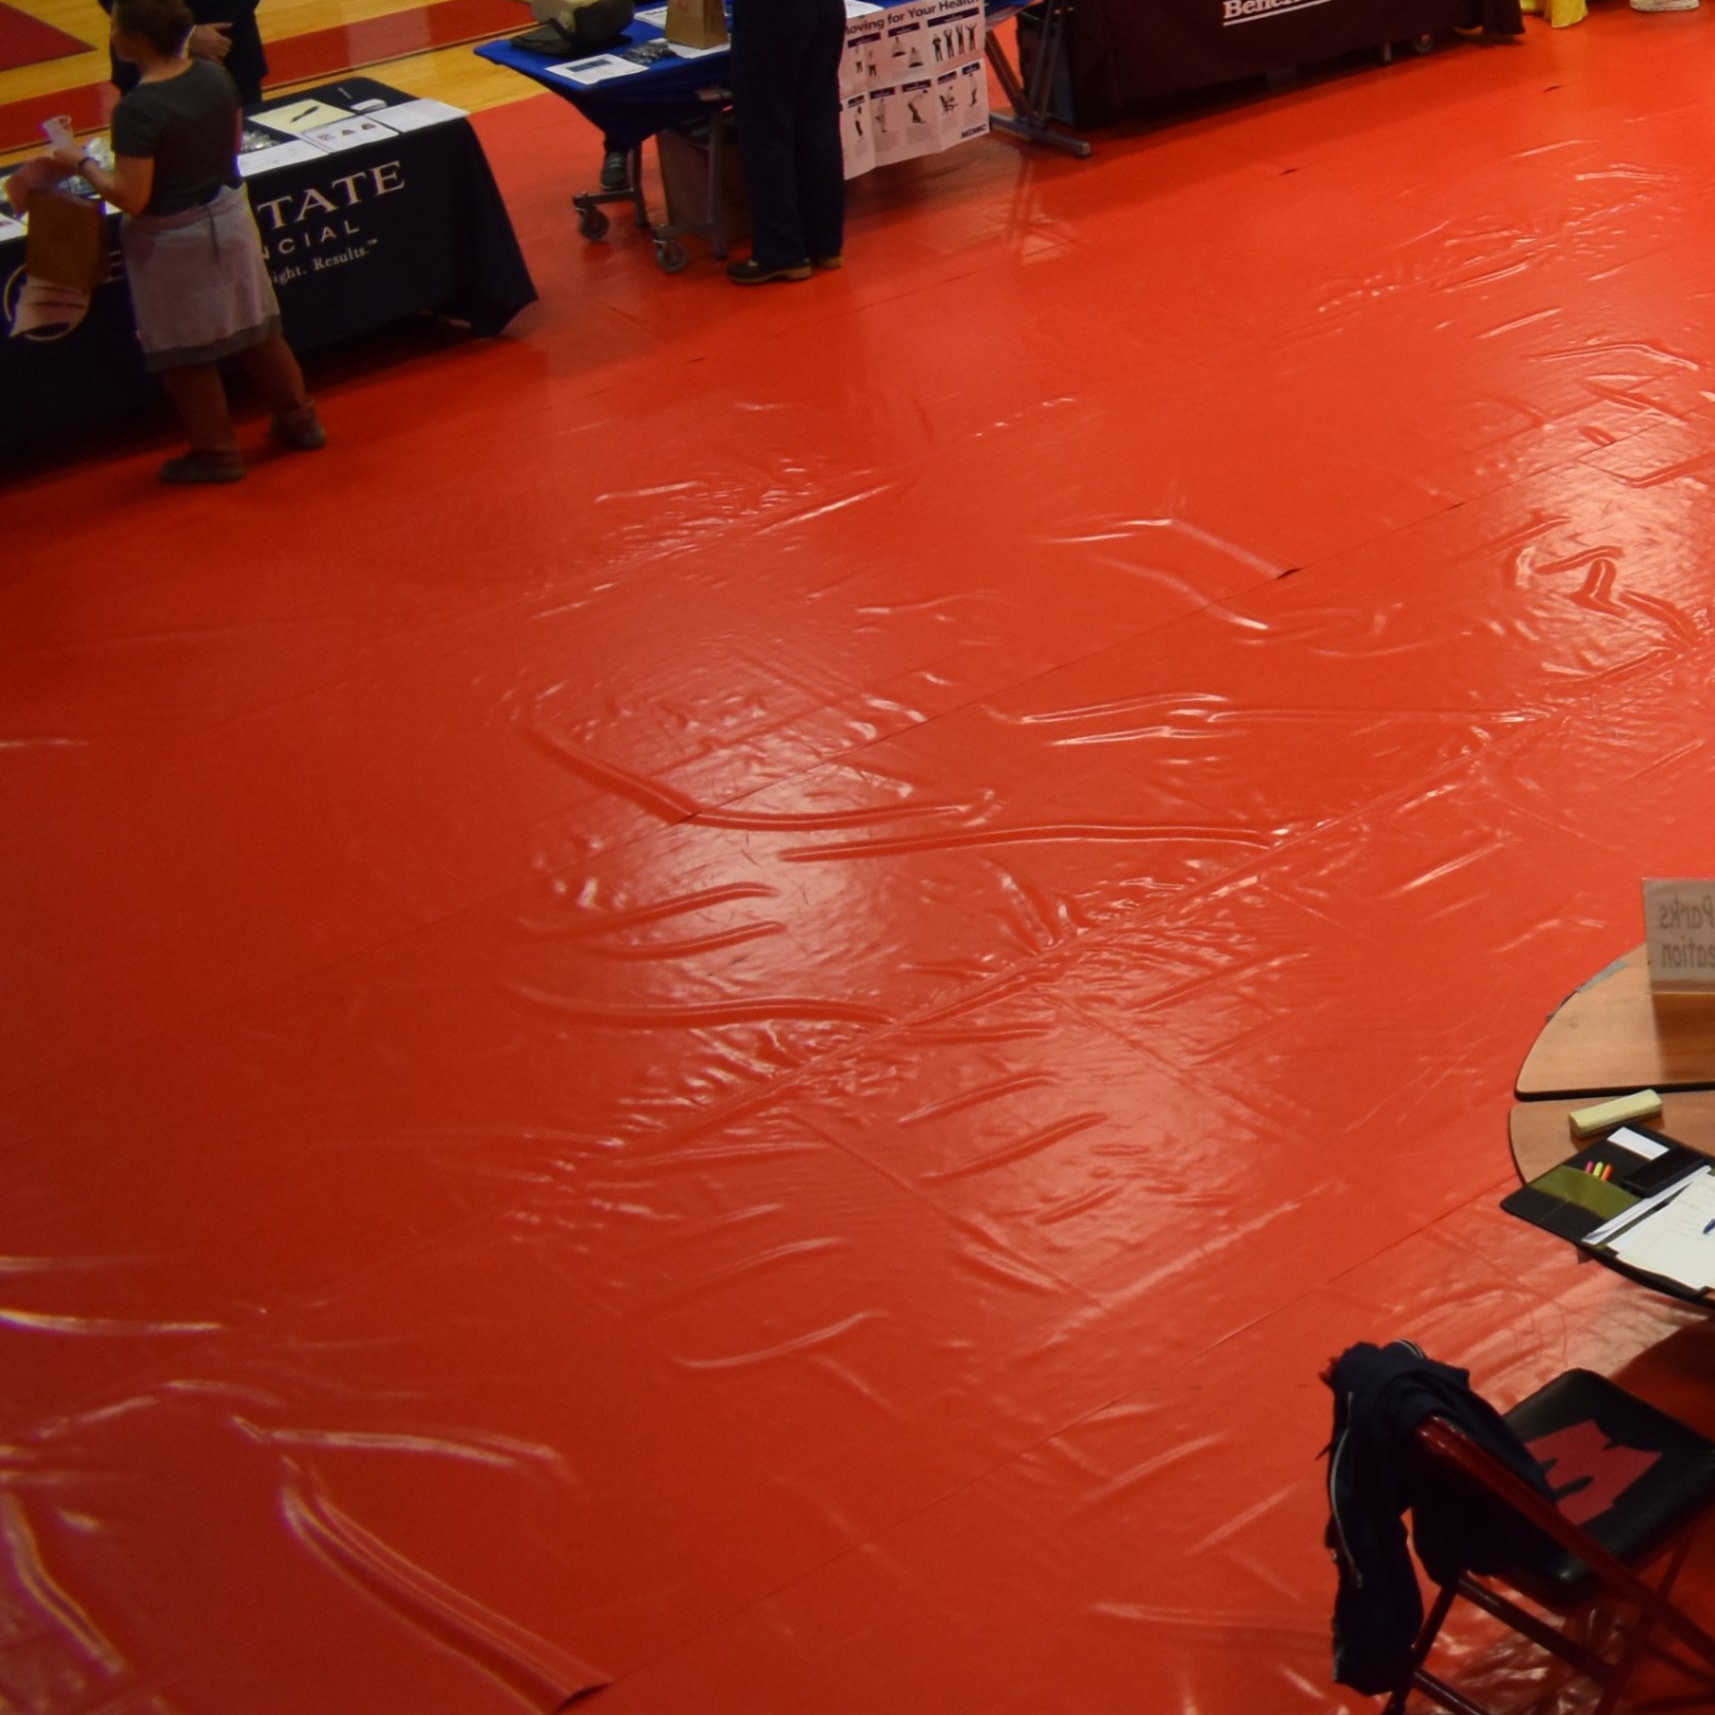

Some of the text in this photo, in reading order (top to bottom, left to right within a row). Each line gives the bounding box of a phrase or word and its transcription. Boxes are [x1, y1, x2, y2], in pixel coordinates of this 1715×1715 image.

[887, 12, 905, 26] for
[907, 3, 936, 19] Your
[257, 160, 405, 230] TATE
